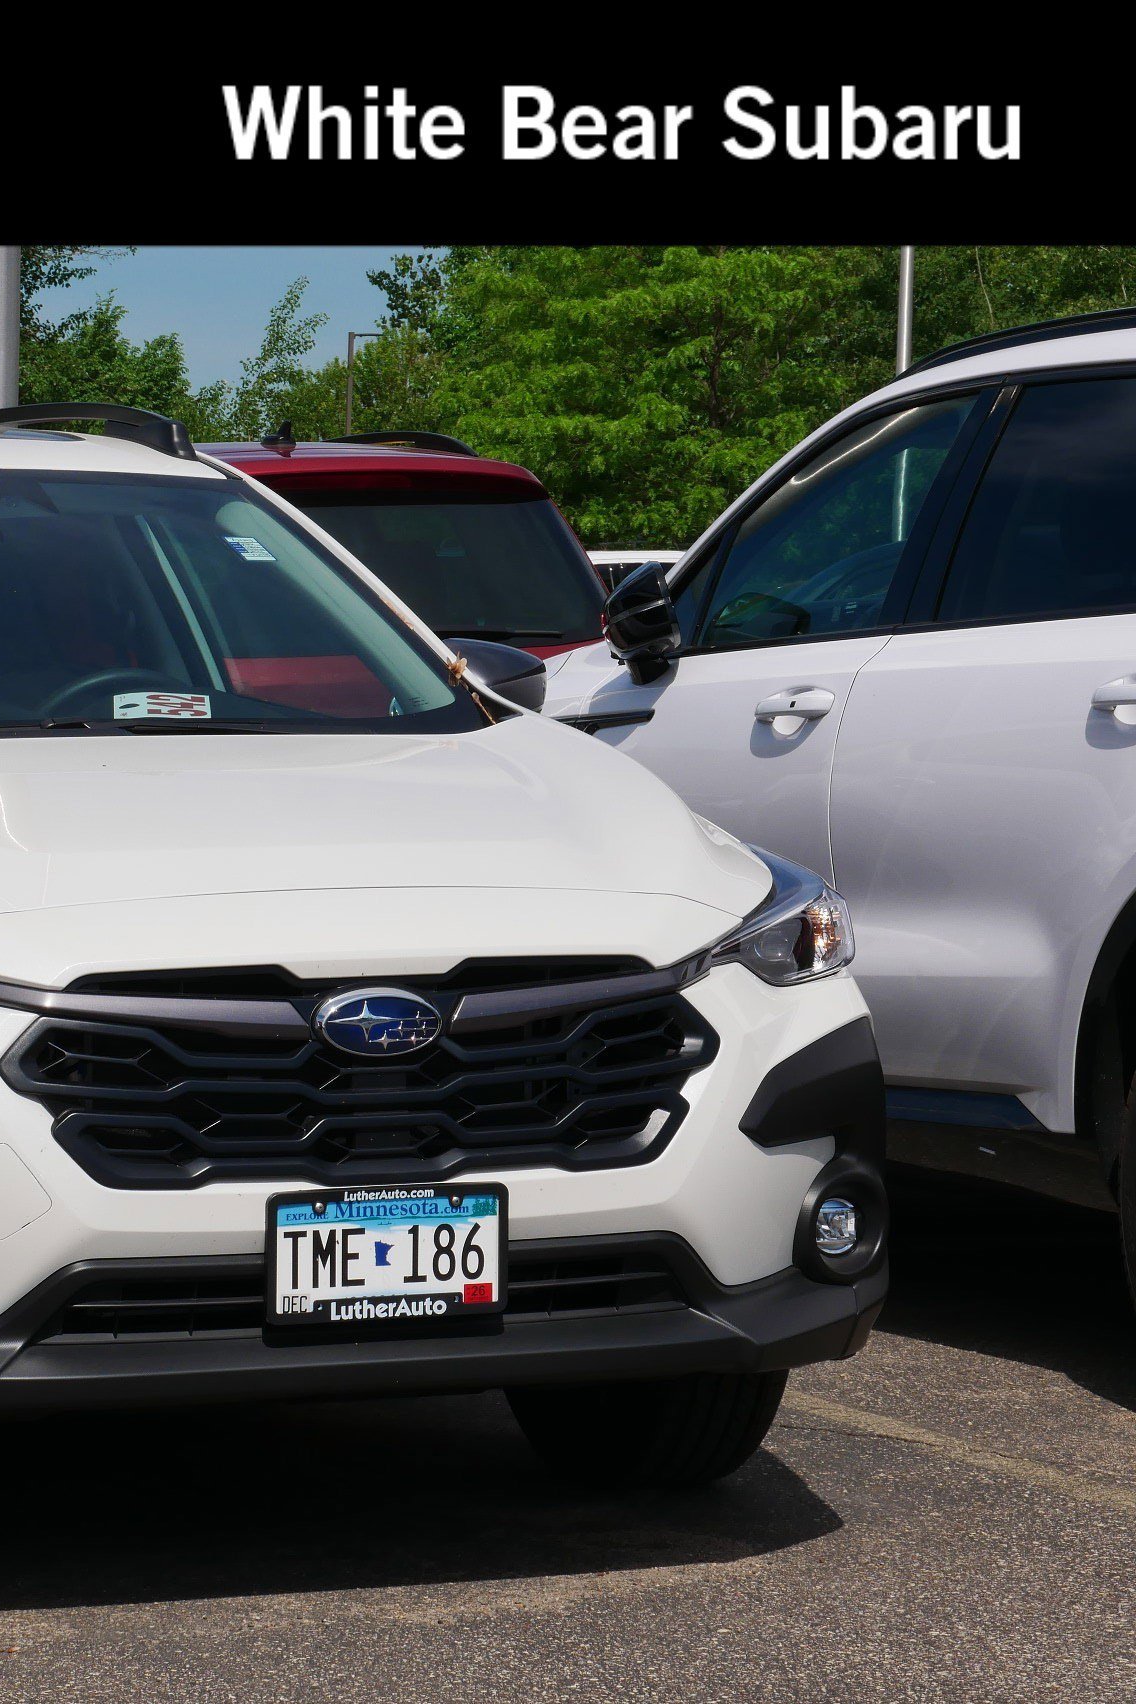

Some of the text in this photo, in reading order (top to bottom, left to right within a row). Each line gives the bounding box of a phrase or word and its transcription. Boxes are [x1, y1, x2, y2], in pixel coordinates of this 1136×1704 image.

[146, 694, 208, 717] 542
[343, 1187, 435, 1202] LutherAuto.com
[283, 1222, 485, 1290] TME 186
[471, 1286, 486, 1297] 26
[282, 1295, 307, 1313] DEC
[330, 1297, 448, 1321] LutherAuto
